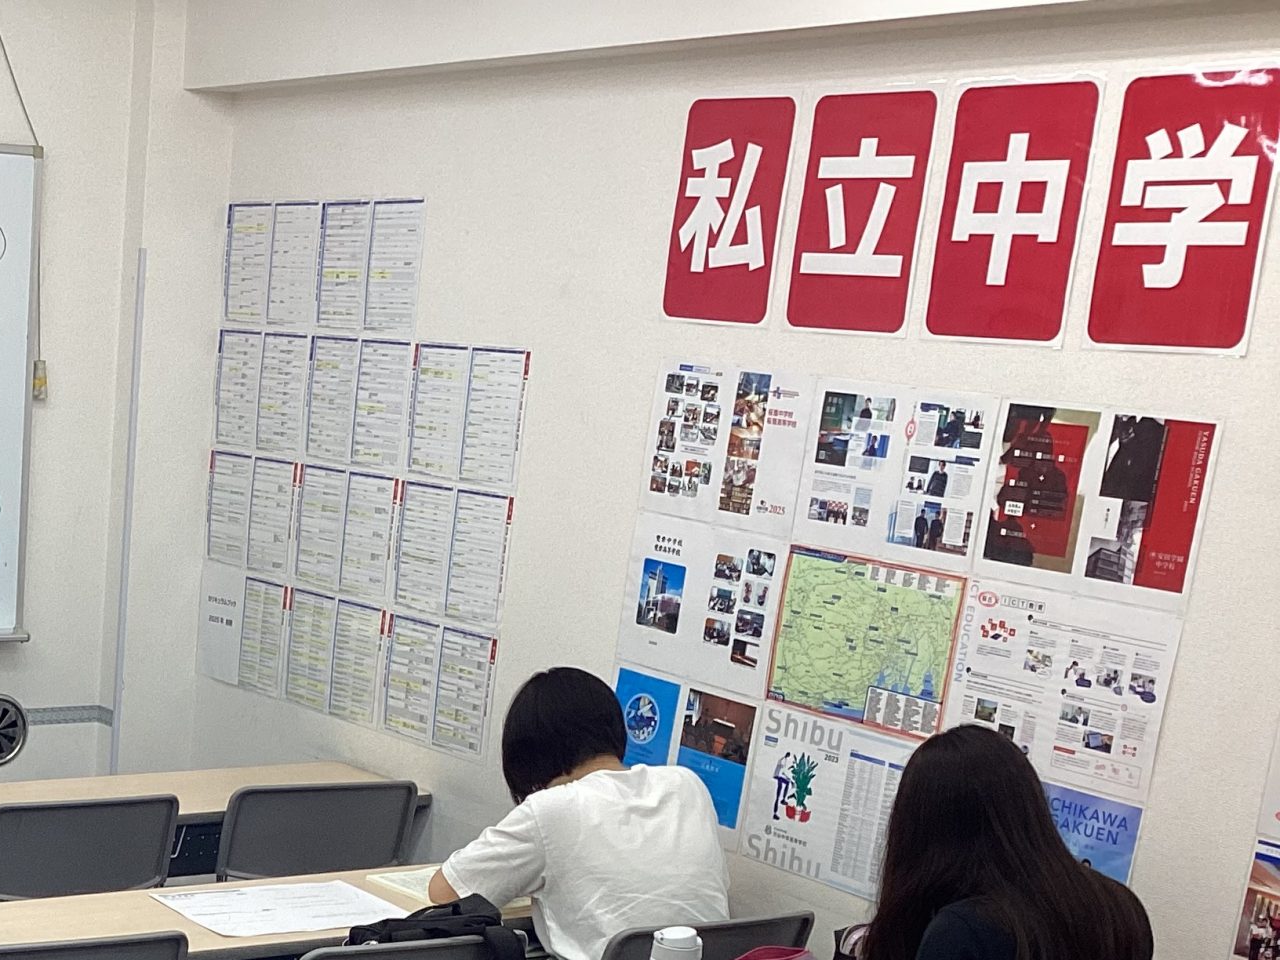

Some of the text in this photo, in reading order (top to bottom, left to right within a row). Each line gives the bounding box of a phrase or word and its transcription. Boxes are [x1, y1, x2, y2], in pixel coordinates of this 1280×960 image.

[678, 122, 1260, 290] 私立中学
[954, 605, 976, 682] EDUCATION
[765, 708, 844, 751] Shibu
